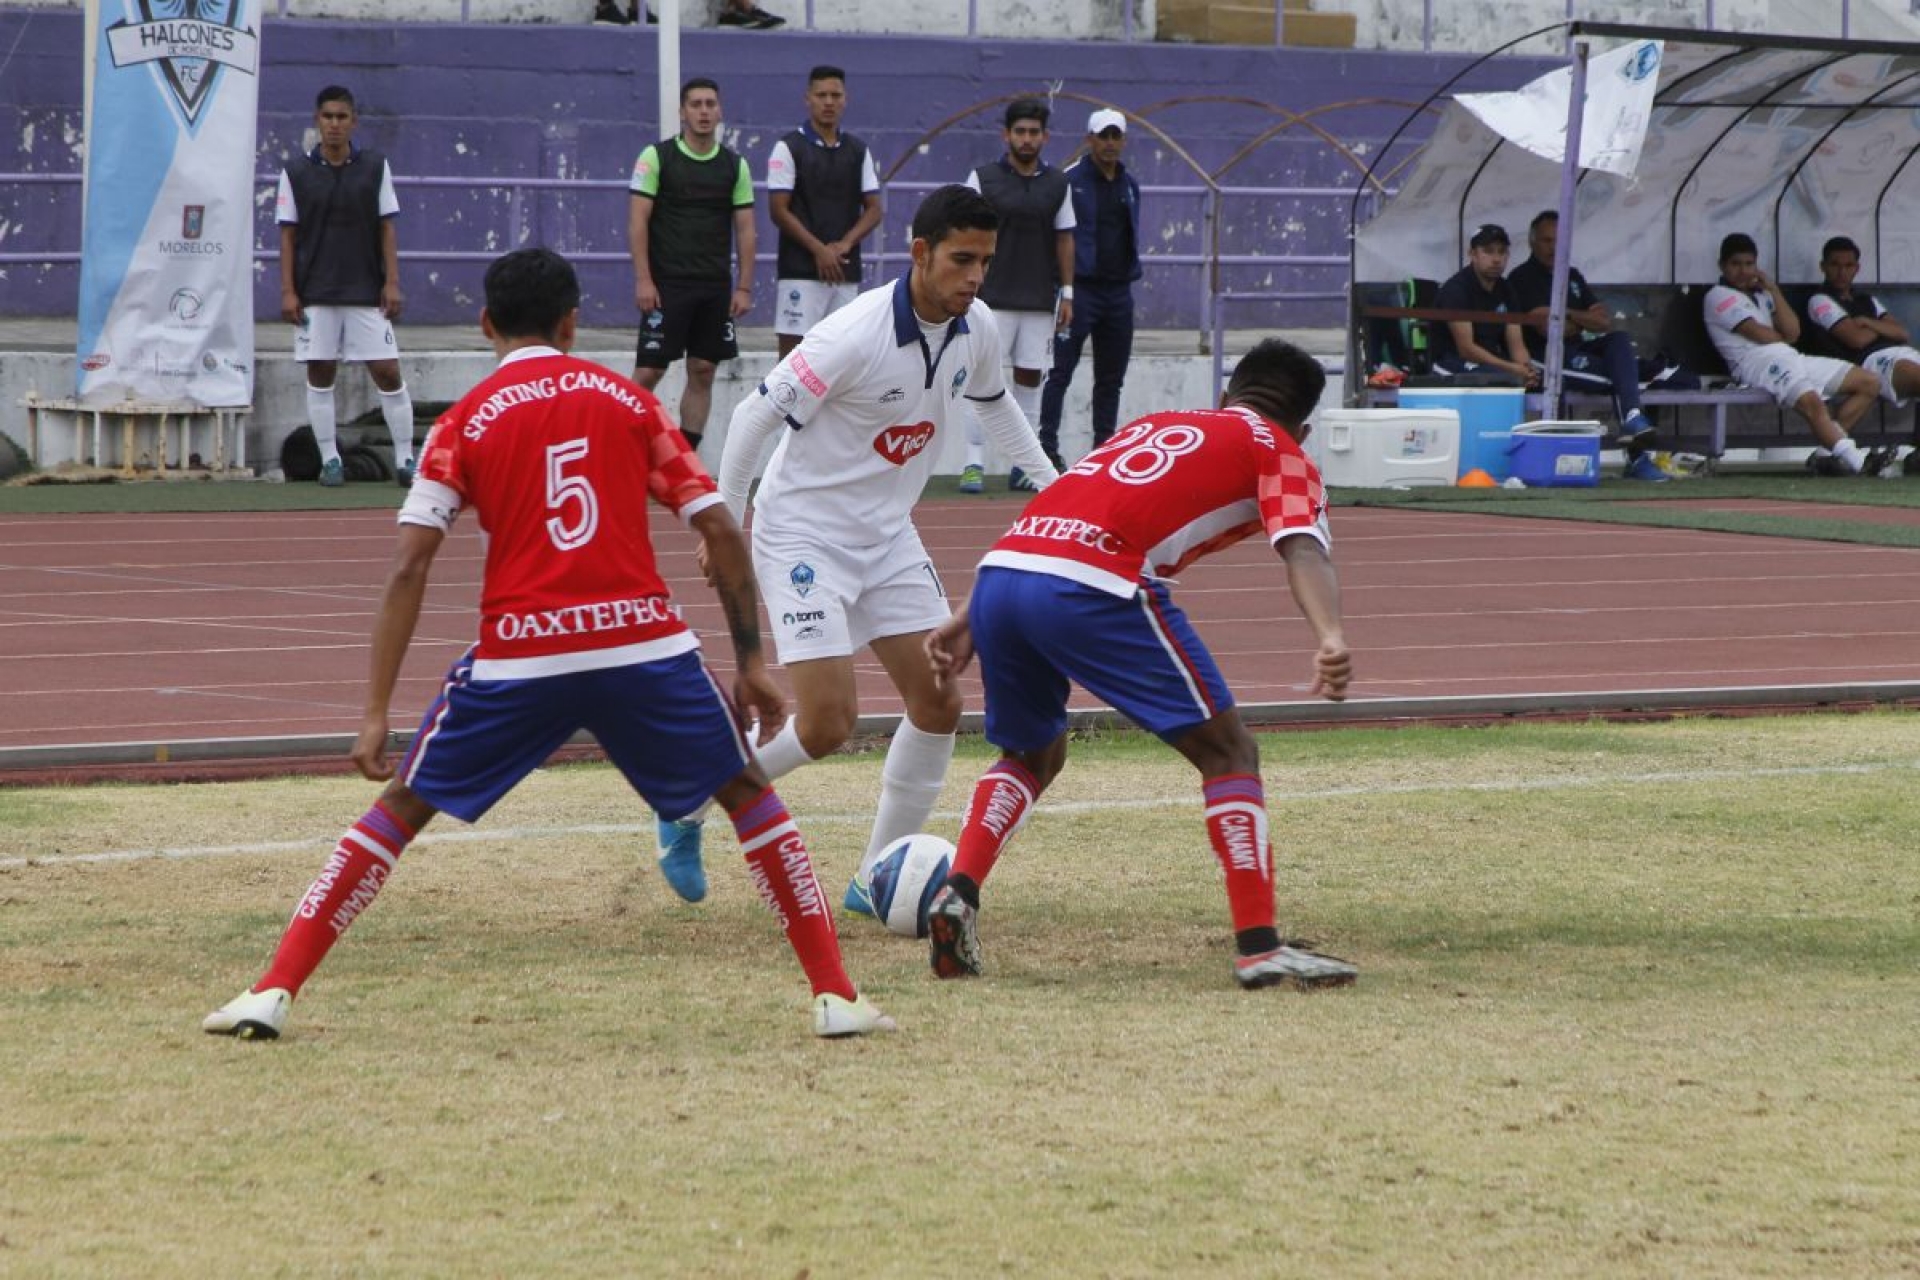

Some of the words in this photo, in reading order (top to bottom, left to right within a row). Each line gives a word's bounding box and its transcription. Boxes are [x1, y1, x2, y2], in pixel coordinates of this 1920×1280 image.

[140, 23, 235, 51] HALCONES
[159, 242, 223, 255] MORELOS
[722, 321, 735, 342] 3
[463, 377, 558, 442] SPORTING
[1072, 422, 1205, 485] 28
[545, 437, 599, 551] 5
[496, 596, 668, 641] OAXTEPEC
[796, 609, 827, 622] torre
[1219, 815, 1258, 870] CANAMY
[300, 843, 353, 919] CANAMY
[328, 863, 388, 935] CANAMY
[779, 836, 821, 917] CANAMY
